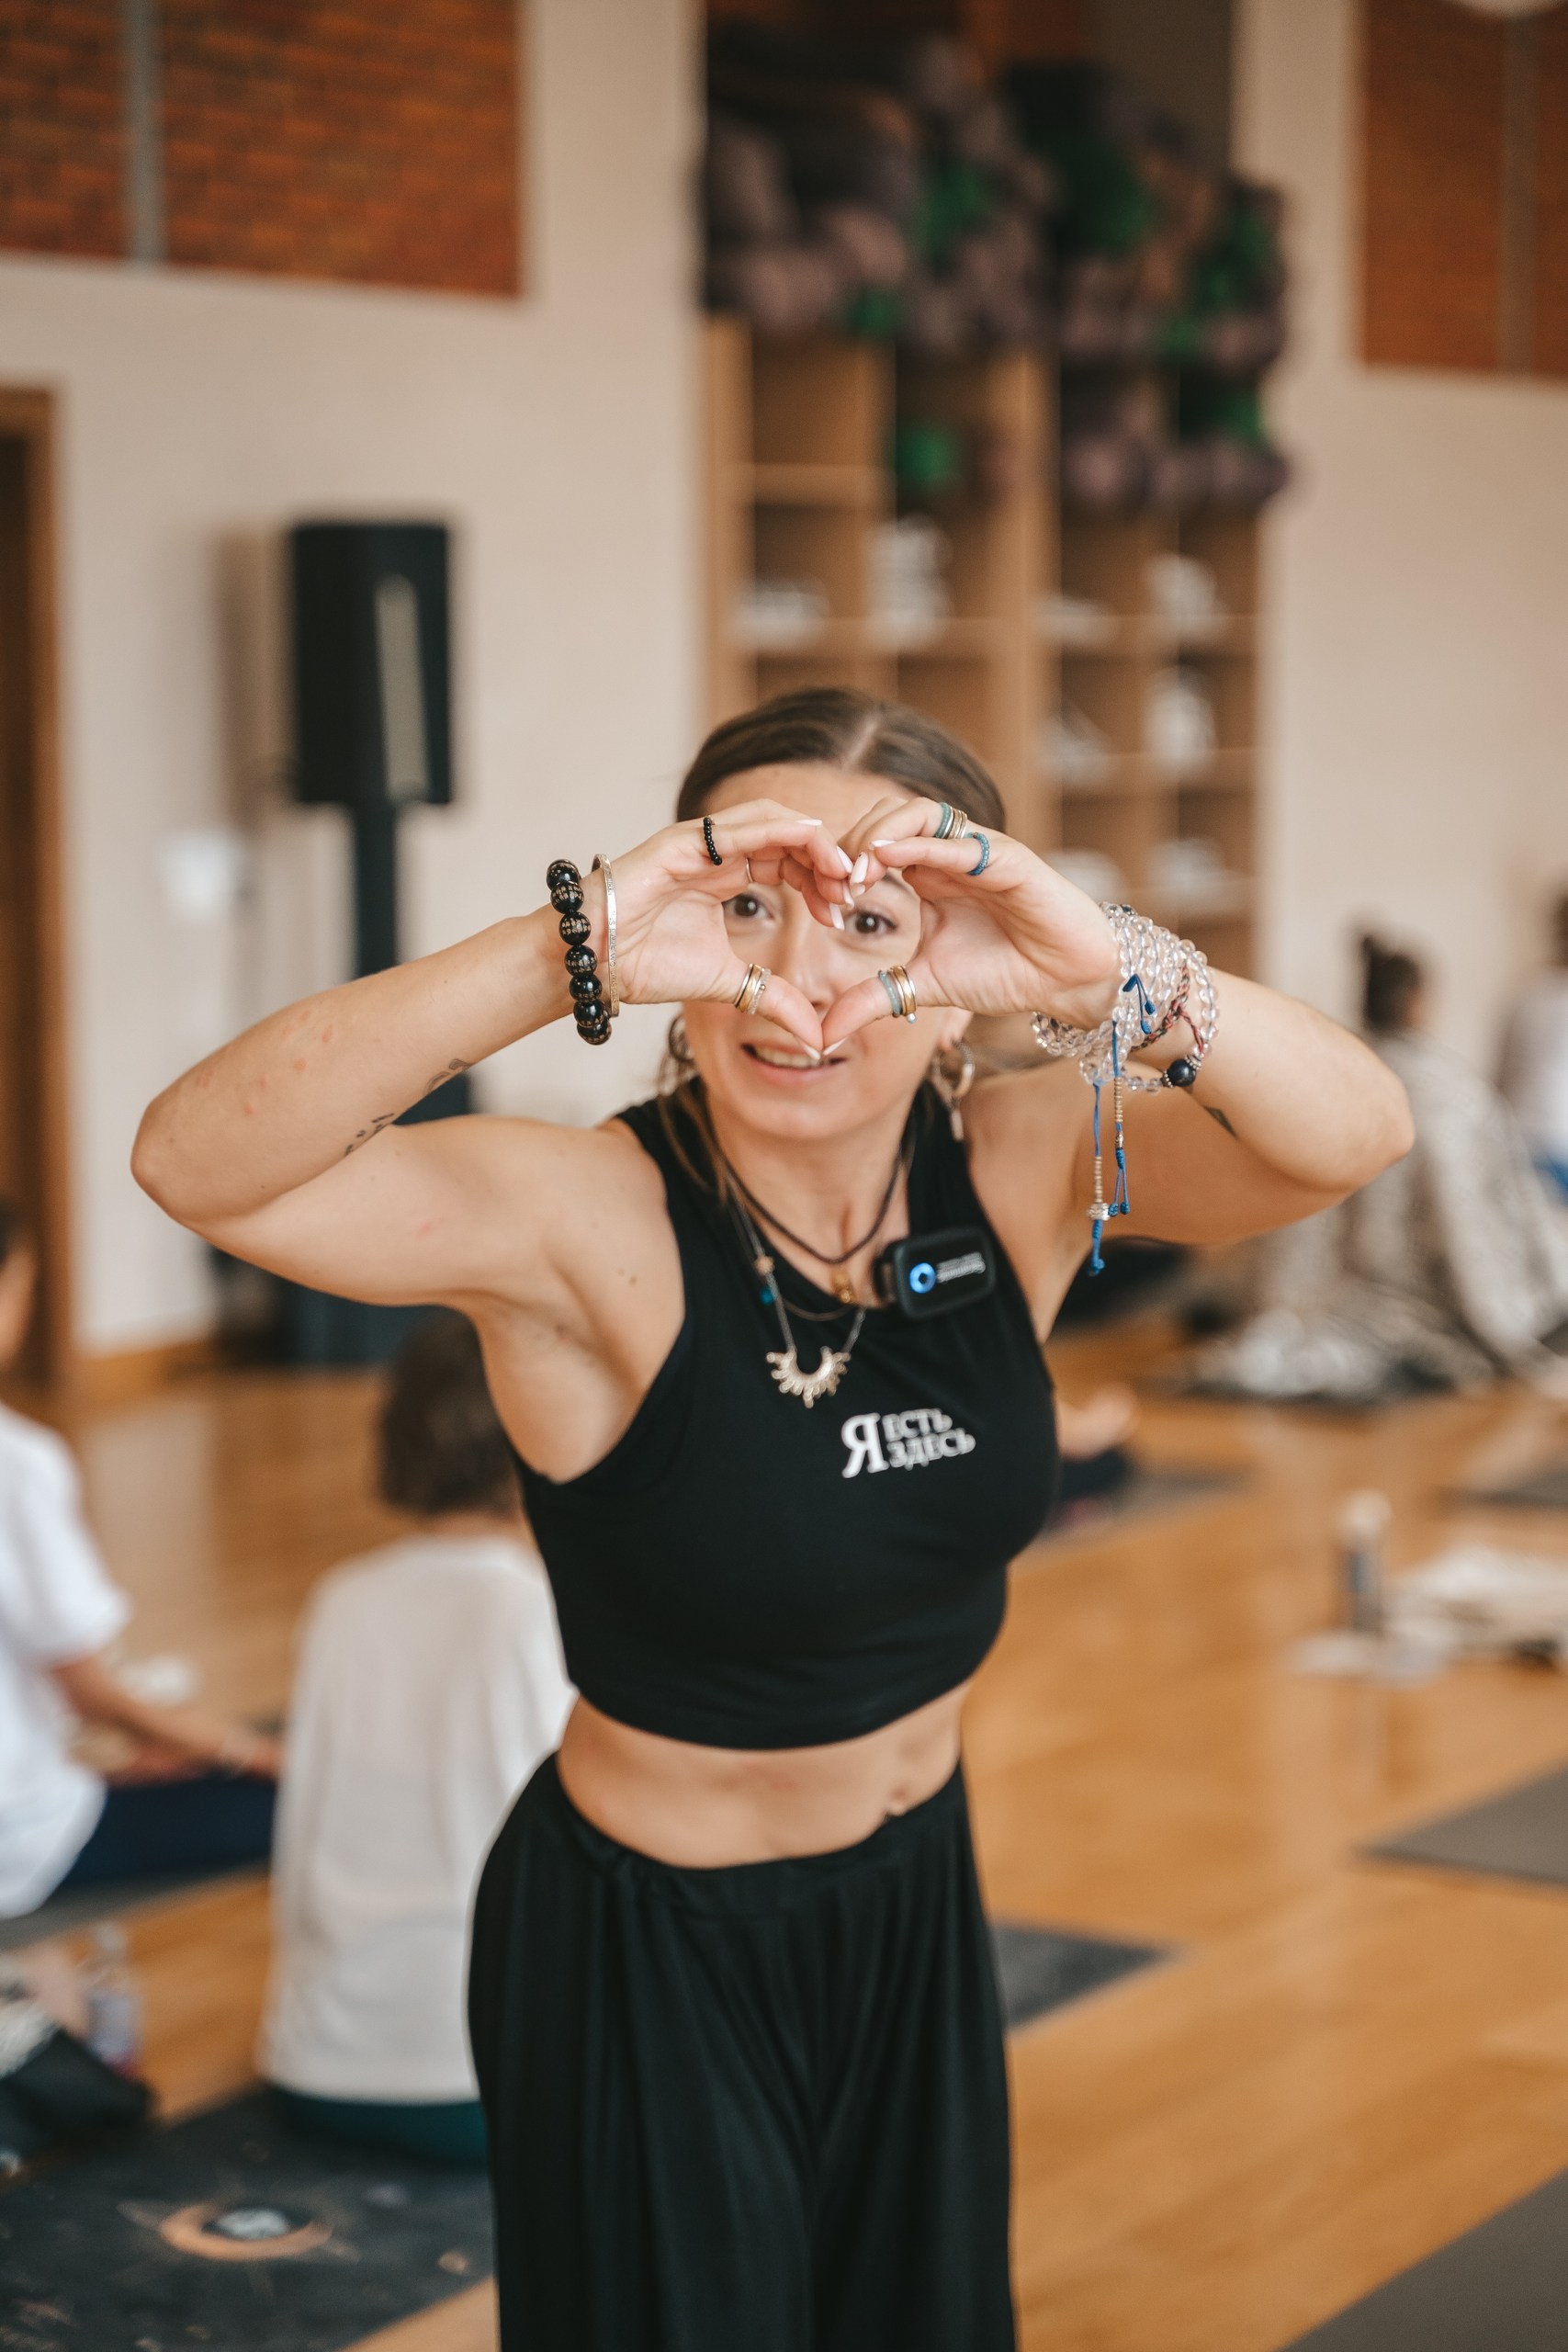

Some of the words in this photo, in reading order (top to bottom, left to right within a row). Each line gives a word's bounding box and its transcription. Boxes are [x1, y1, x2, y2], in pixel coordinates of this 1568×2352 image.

[841, 1412, 889, 1478] Я
[882, 1408, 953, 1442] ЕСТЬ
[886, 1428, 976, 1470] ЗДЕСЬ
